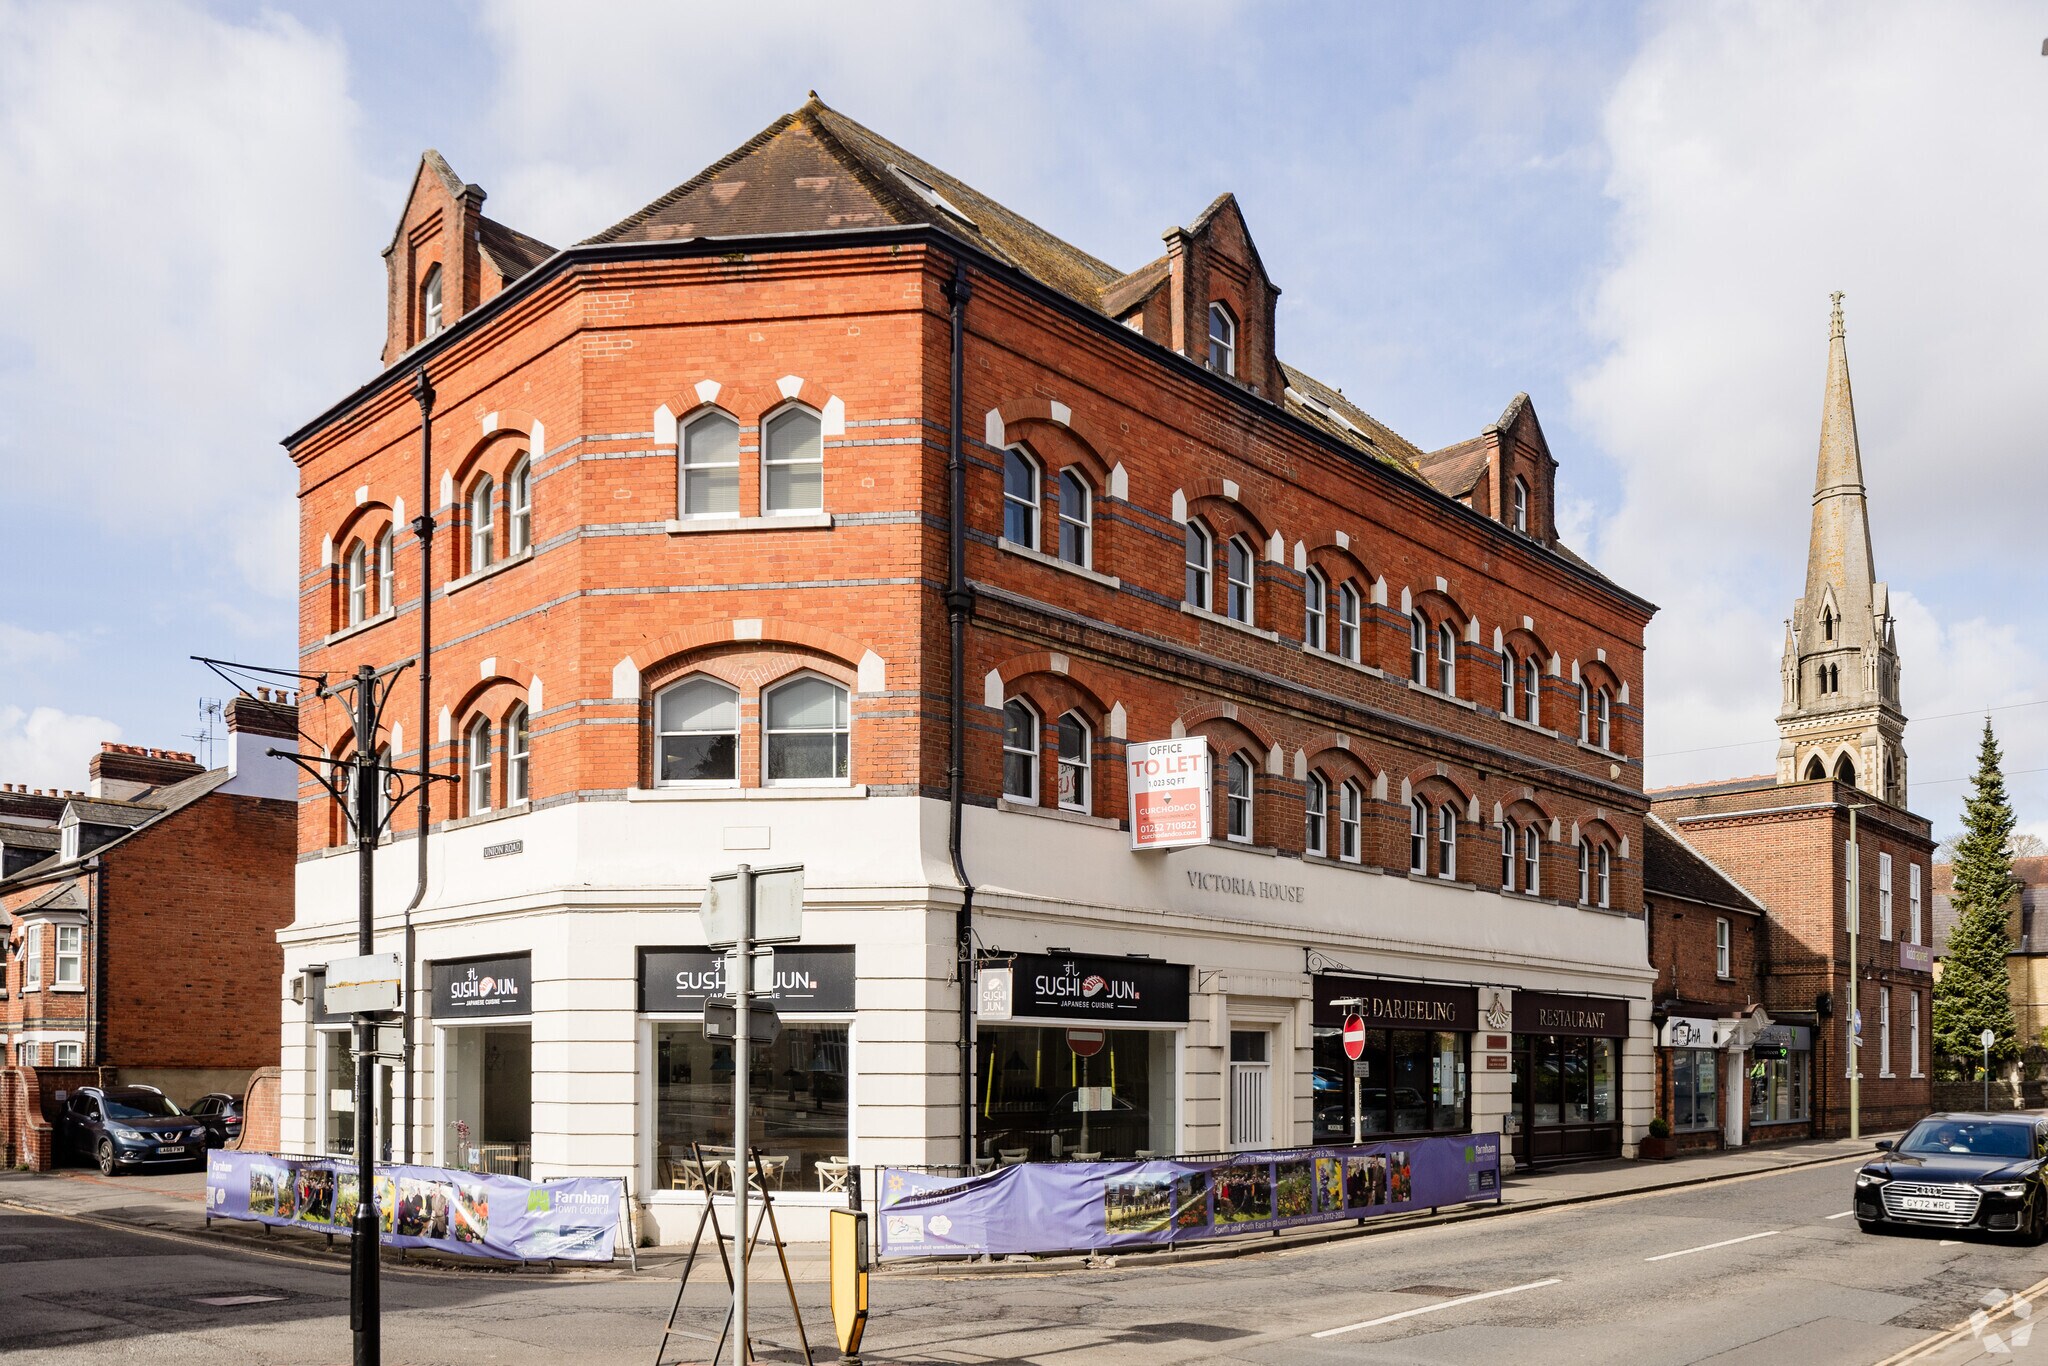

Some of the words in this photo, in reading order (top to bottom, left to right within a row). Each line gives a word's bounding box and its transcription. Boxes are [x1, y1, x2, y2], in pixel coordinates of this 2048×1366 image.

[1150, 744, 1182, 755] OFFICE
[1132, 760, 1160, 777] TO
[1166, 755, 1201, 773] LET
[1149, 779, 1165, 788] 1,023
[1166, 778, 1176, 786] SQ
[1140, 824, 1164, 833] 01252
[1166, 821, 1196, 831] 710822
[484, 846, 504, 856] UNION
[504, 843, 521, 854] ROAD
[1187, 871, 1255, 897] VICTORIA
[1259, 881, 1304, 903] HOUSE
[676, 972, 726, 989] SUSH
[773, 972, 809, 989] JUN
[451, 980, 479, 998] SUSHI
[494, 978, 514, 995] JUN
[1036, 975, 1080, 996] SUSHI
[1106, 980, 1134, 999] JUN
[983, 991, 1006, 1001] SUSHI
[985, 1001, 1001, 1011] JUN
[1060, 1000, 1089, 1008] JAPANESE
[1373, 998, 1456, 1021] DARJEELING
[1540, 1008, 1605, 1028] RESTAURANT
[213, 1161, 232, 1172] Farnham
[911, 1184, 968, 1196] Farnham
[555, 1190, 609, 1204] Farnham
[555, 1204, 577, 1214] Town
[580, 1204, 608, 1214] Council
[1907, 1199, 1930, 1208] GY72
[1933, 1201, 1950, 1209] WRG
[1215, 1225, 1230, 1234] South
[1231, 1223, 1241, 1232] and
[1242, 1222, 1254, 1231] South
[1255, 1220, 1266, 1229] East
[1266, 1220, 1272, 1228] in
[1272, 1218, 1288, 1227] Bloom
[1288, 1216, 1307, 1226] Category
